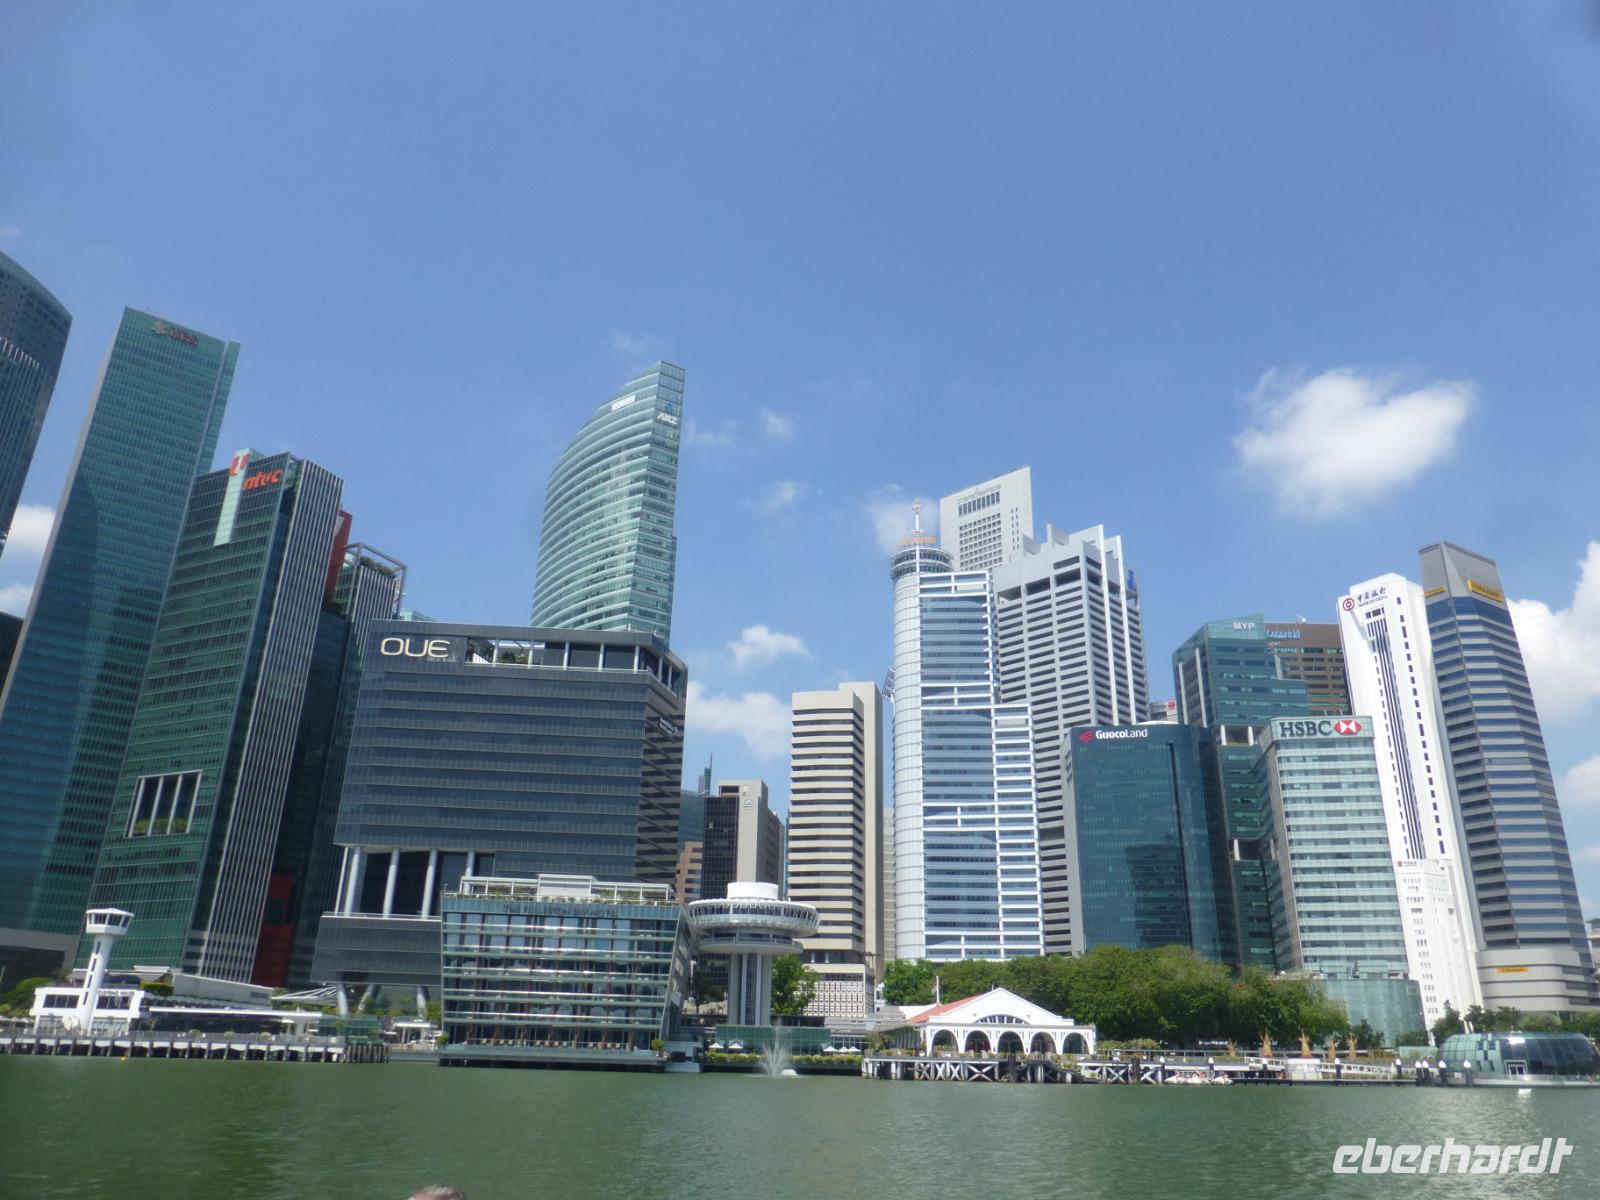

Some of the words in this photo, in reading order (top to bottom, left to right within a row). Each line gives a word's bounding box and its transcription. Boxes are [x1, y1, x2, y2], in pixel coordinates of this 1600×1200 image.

[243, 469, 282, 490] ntuc
[1233, 621, 1255, 630] MYP
[381, 637, 451, 657] OUE
[1095, 728, 1148, 739] GuocoLand
[1280, 720, 1332, 737] HSBC
